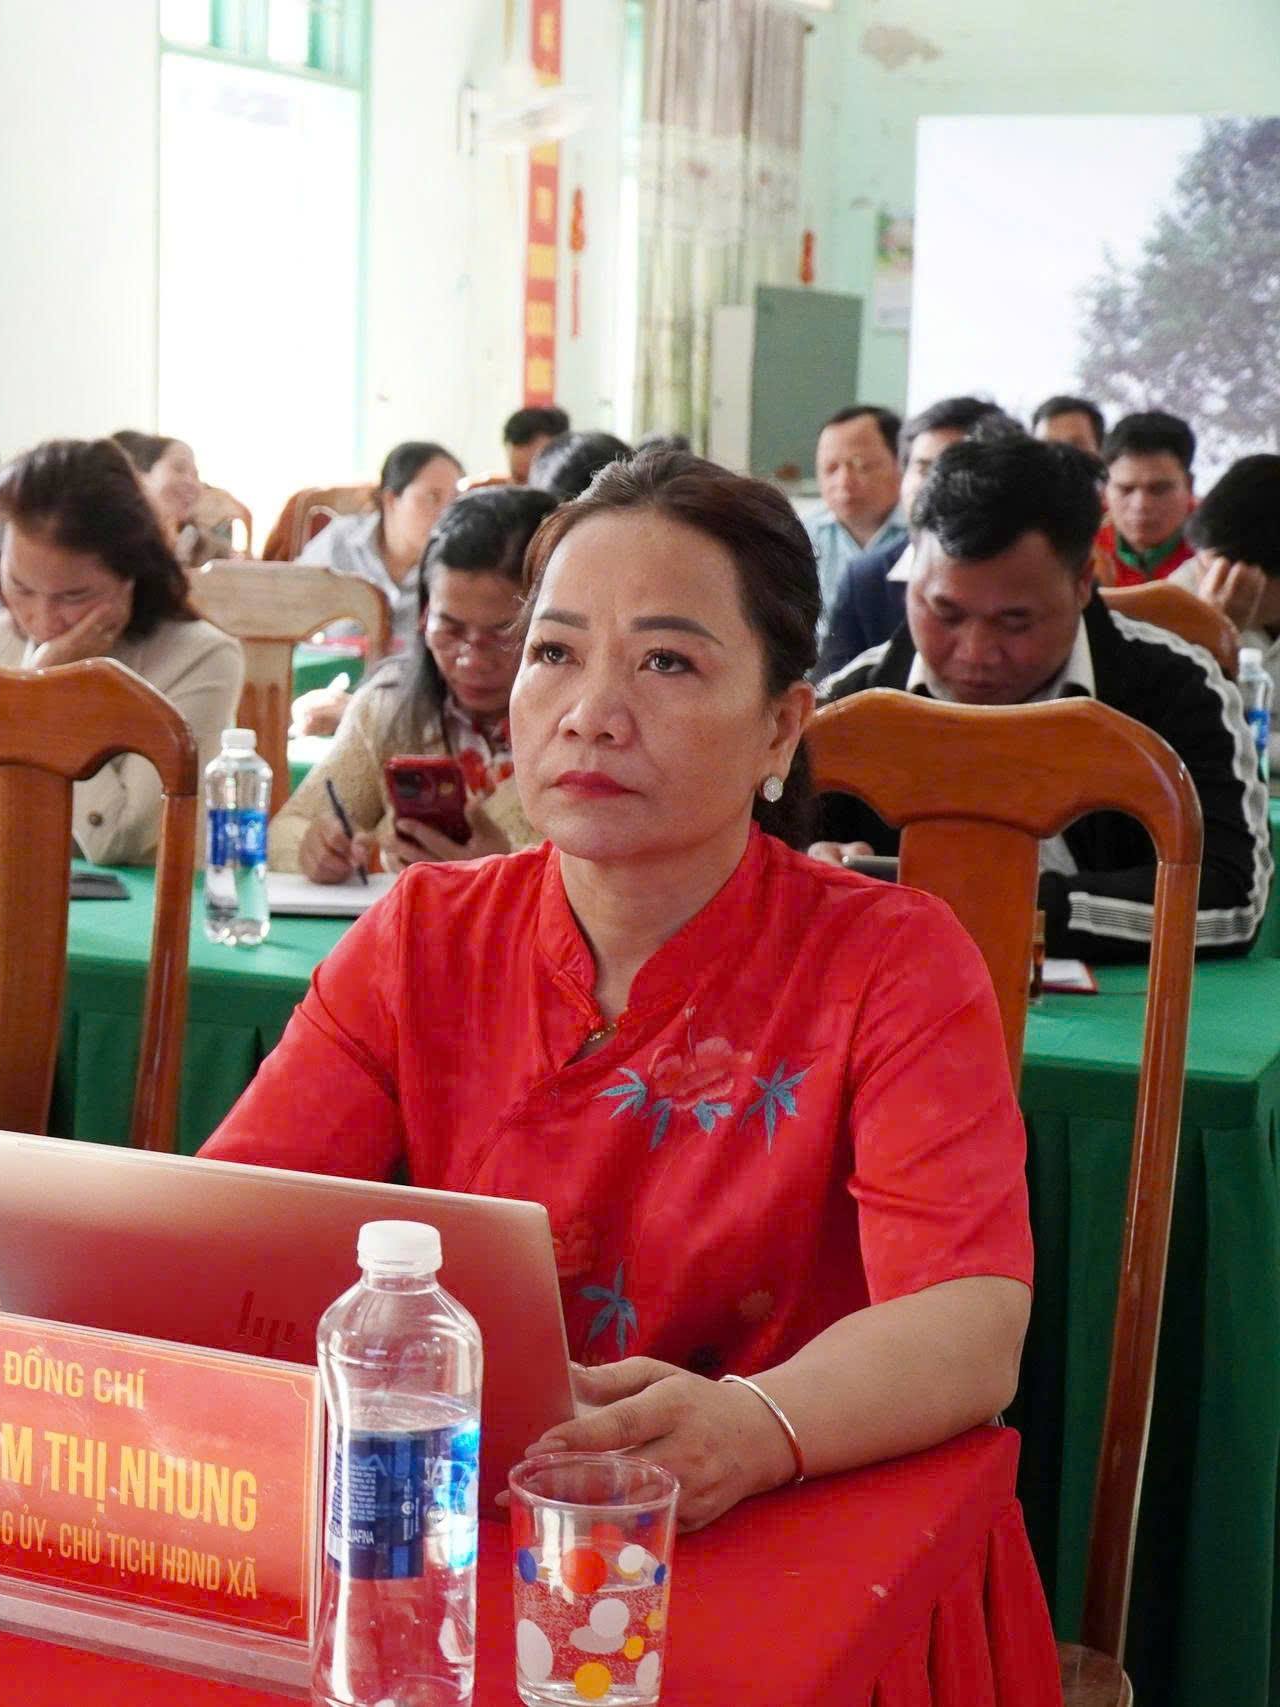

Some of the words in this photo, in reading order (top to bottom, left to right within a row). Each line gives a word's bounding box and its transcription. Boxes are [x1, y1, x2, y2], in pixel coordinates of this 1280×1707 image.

[3, 1344, 84, 1398] ĐỒNG
[94, 1367, 147, 1411] CHÍ
[44, 1430, 108, 1514] THỊ
[119, 1444, 257, 1532] NHUNG
[20, 1503, 53, 1559] ỦY,
[59, 1518, 101, 1565] CHỦ
[107, 1532, 156, 1577] TỊCH
[161, 1543, 221, 1591] HĐND
[226, 1556, 257, 1600] XÃ
